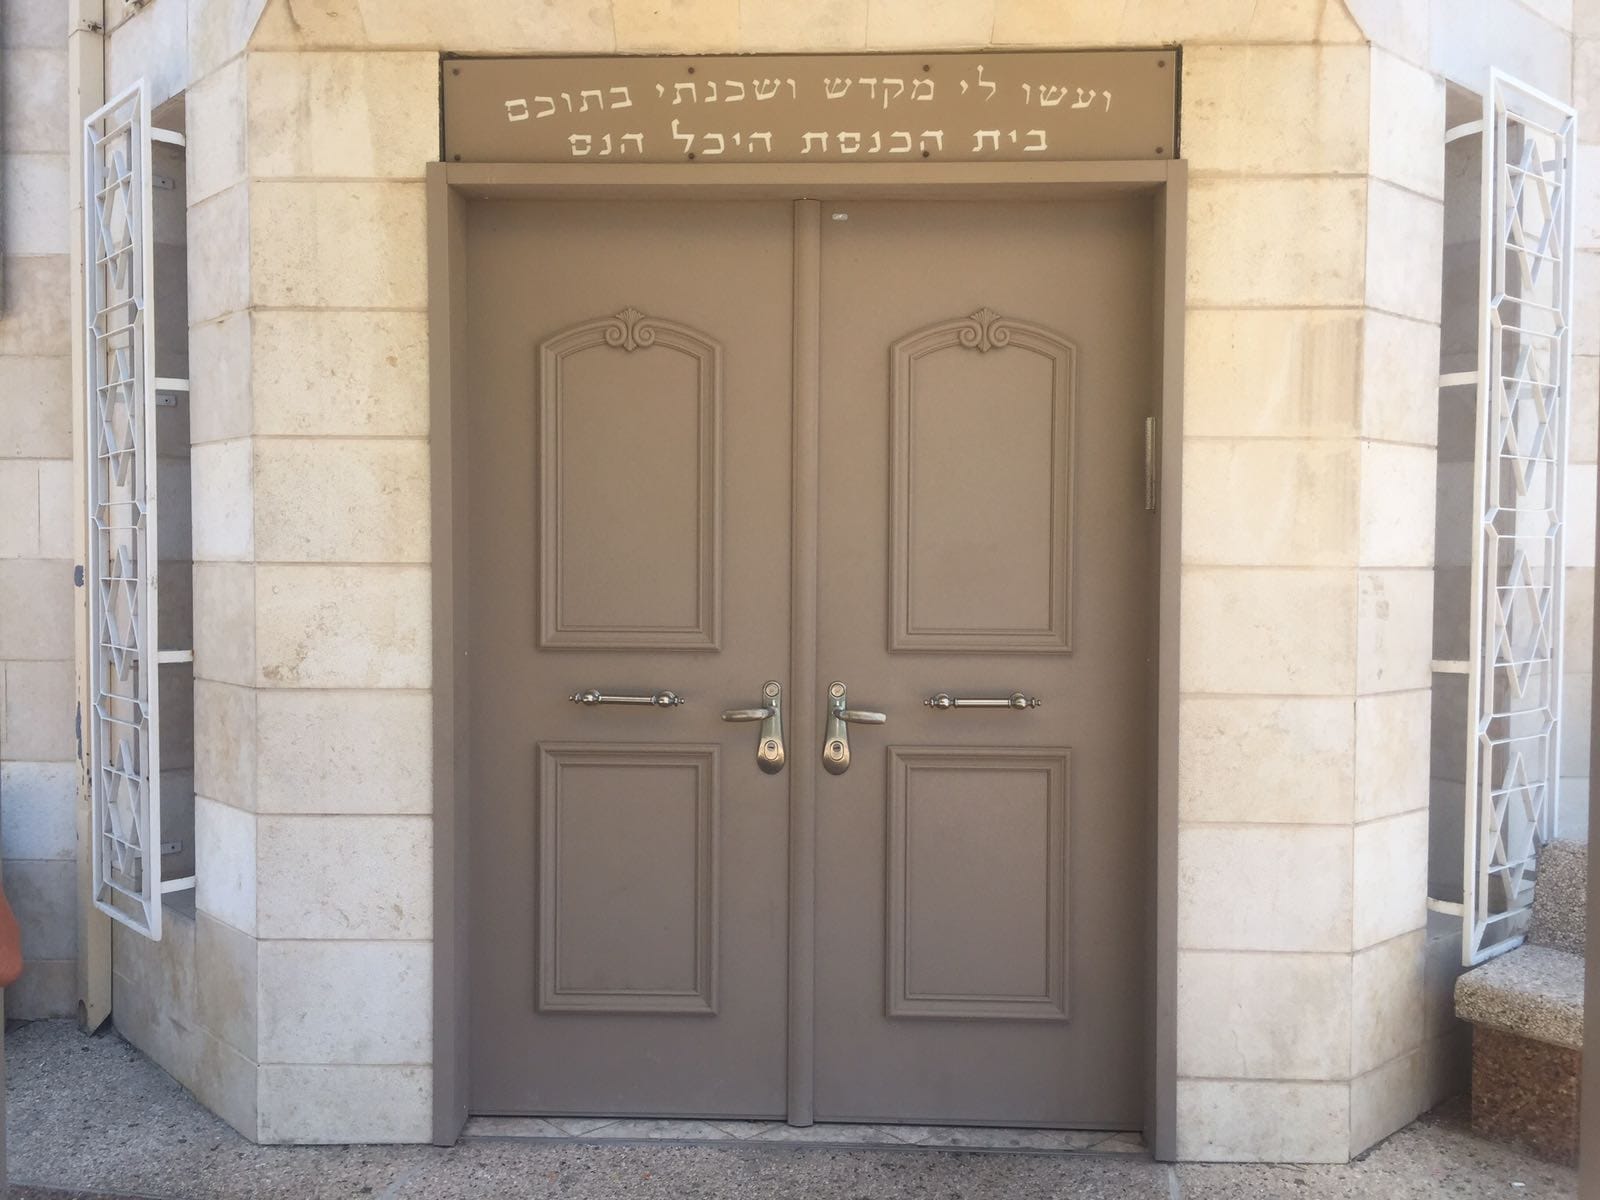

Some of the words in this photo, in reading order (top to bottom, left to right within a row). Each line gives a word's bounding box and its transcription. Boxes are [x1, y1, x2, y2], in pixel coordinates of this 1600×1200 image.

[655, 78, 797, 106] ושכנתי
[823, 77, 935, 110] מקדש
[959, 64, 997, 101] לי
[1021, 82, 1112, 113] ועשו
[504, 86, 633, 123] בתוכם
[671, 118, 773, 155] היכל
[800, 129, 944, 154] הכנסת
[971, 128, 1048, 153] בית
